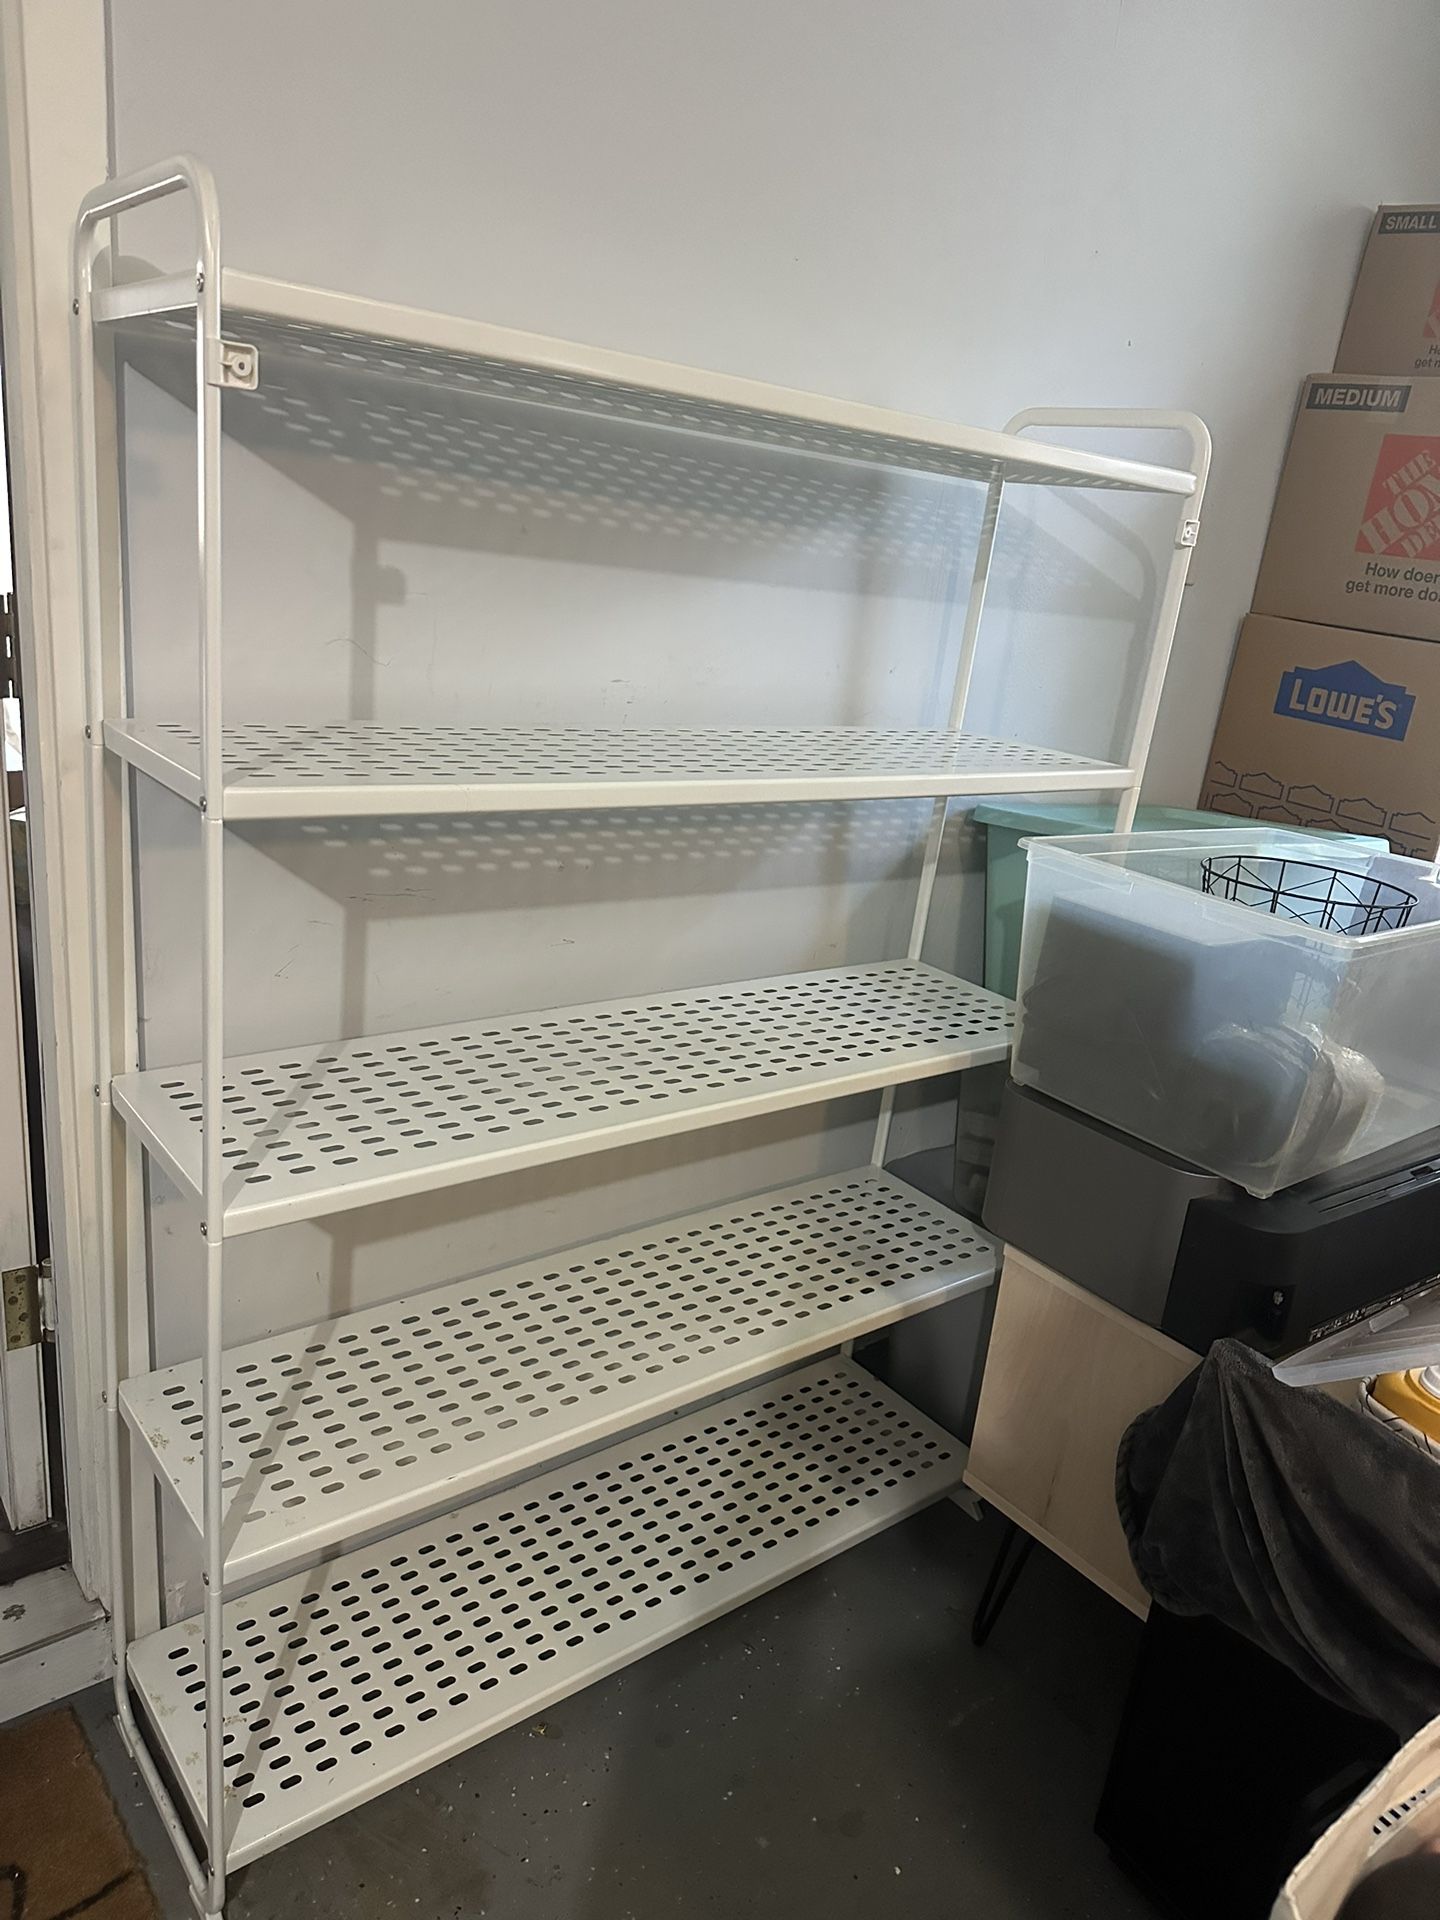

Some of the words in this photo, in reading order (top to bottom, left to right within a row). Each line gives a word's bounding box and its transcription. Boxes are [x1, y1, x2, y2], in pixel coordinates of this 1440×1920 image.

[1385, 214, 1437, 230] SMALL
[1314, 387, 1401, 408] MEDIUM
[1382, 450, 1437, 496] THE
[1365, 562, 1400, 579] How
[1345, 580, 1371, 593] get
[1373, 583, 1414, 599] more
[1418, 587, 1440, 602] do
[1288, 679, 1397, 730] LOWE'S
